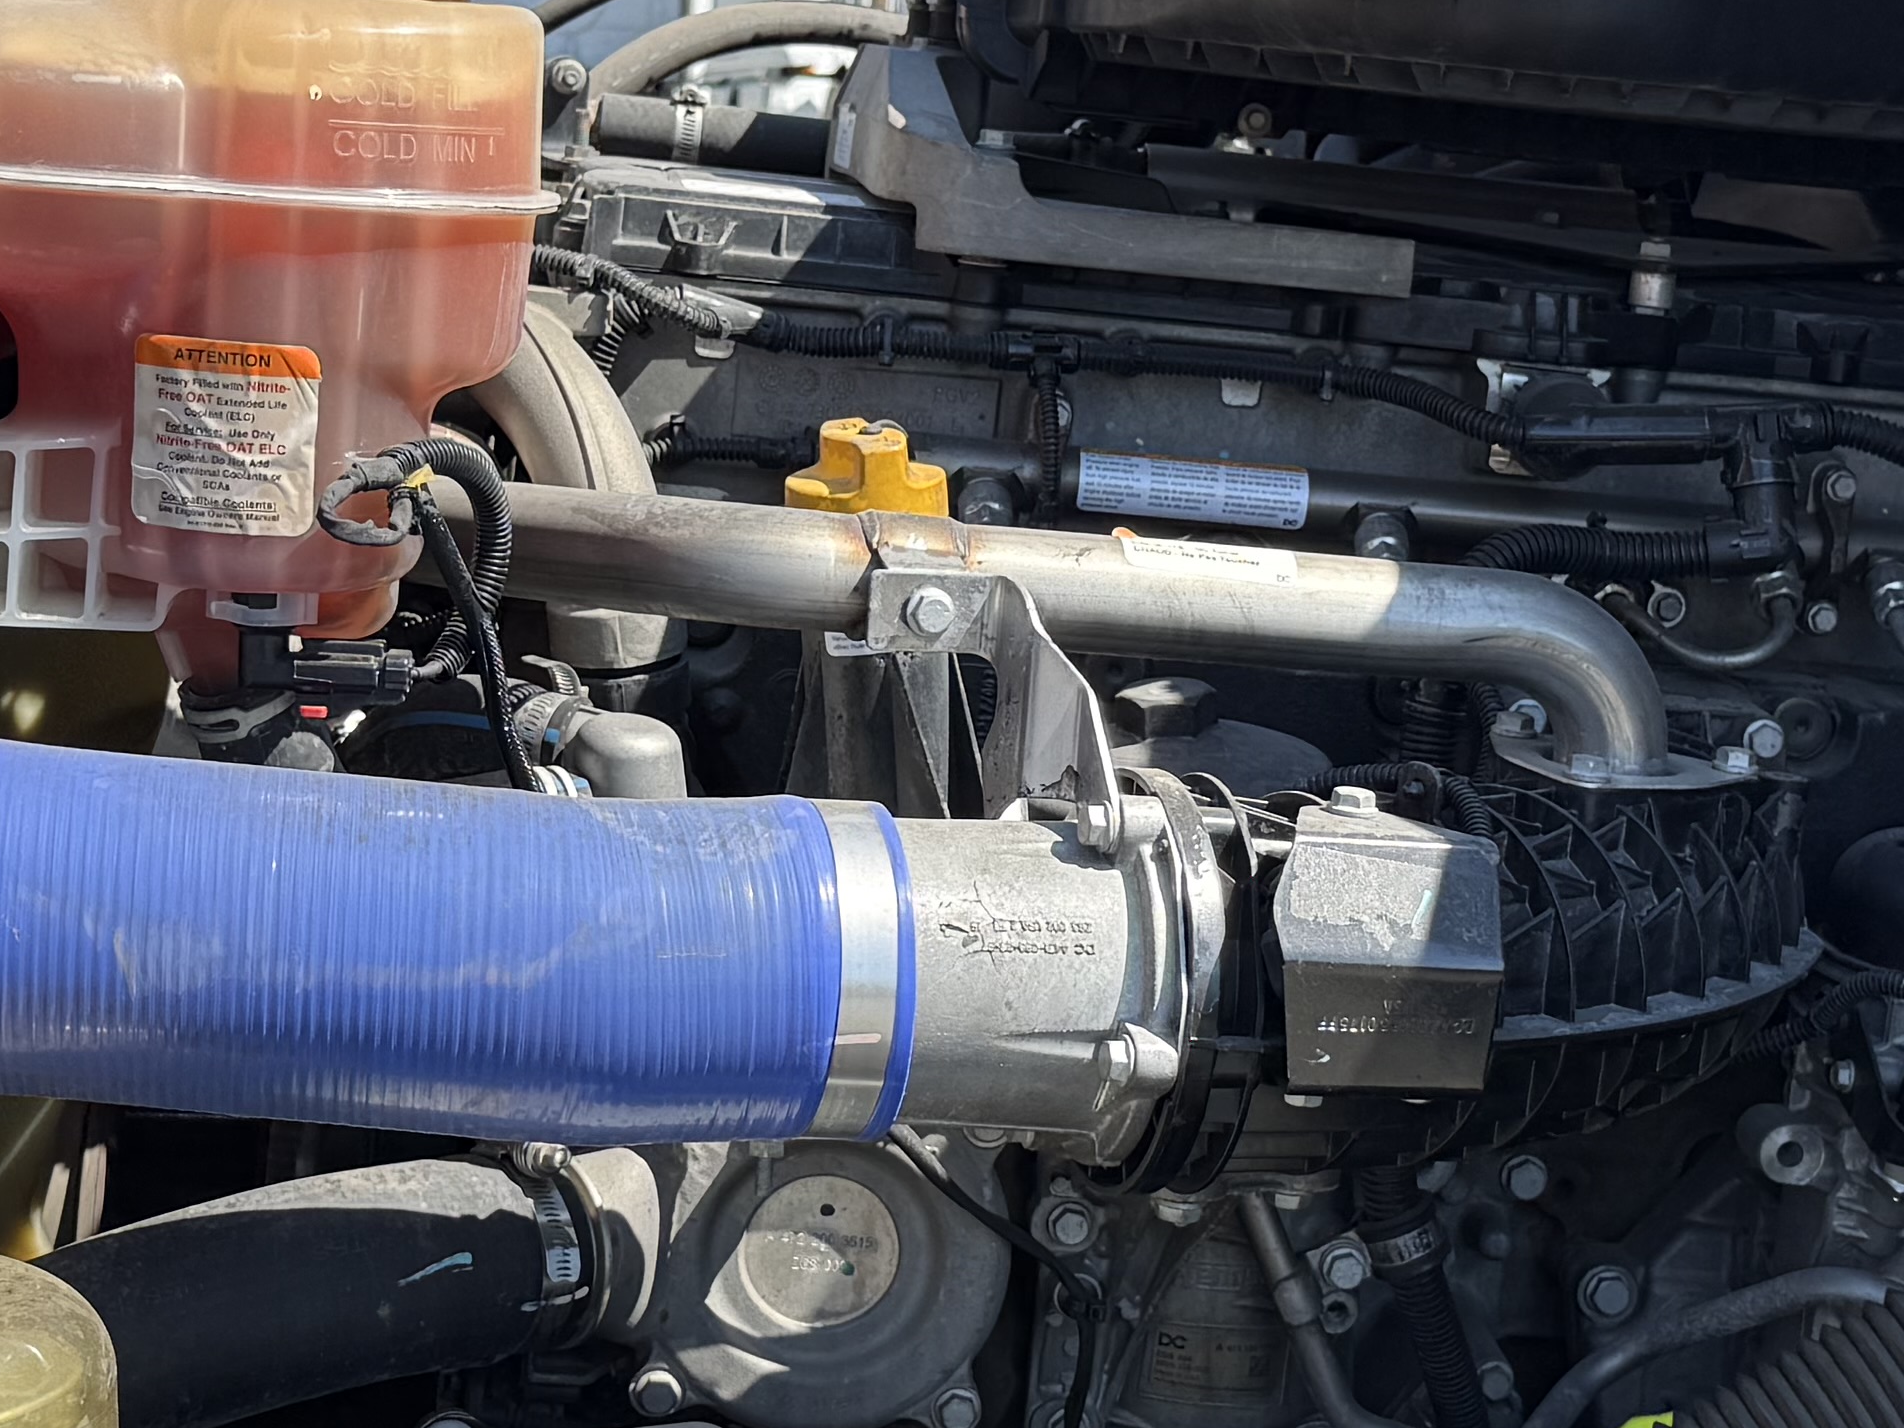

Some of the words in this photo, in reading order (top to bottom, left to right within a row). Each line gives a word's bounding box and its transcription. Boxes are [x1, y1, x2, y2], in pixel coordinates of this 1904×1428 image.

[329, 77, 416, 109] COLD
[333, 130, 417, 160] COLD
[433, 134, 476, 163] MIN
[174, 348, 271, 368] ATTENTION
[156, 374, 189, 389] Factory
[192, 378, 220, 389] Filled
[222, 380, 244, 391] with
[158, 389, 182, 402] Free
[186, 391, 214, 404] OAT
[216, 397, 265, 409] Extended
[268, 400, 287, 410] Life
[226, 412, 255, 423] (ELC)
[165, 422, 182, 433] For
[229, 428, 248, 439] Use
[251, 429, 276, 441] Only
[226, 442, 254, 455] OAT
[259, 443, 287, 456] ELC
[211, 455, 225, 465] Do
[249, 459, 270, 468] Add
[222, 470, 268, 481] Coolants
[271, 473, 282, 482] or
[202, 480, 230, 491] SCAs
[158, 504, 173, 513] See
[175, 506, 205, 517] Engine
[1158, 1330, 1187, 1350] DC
